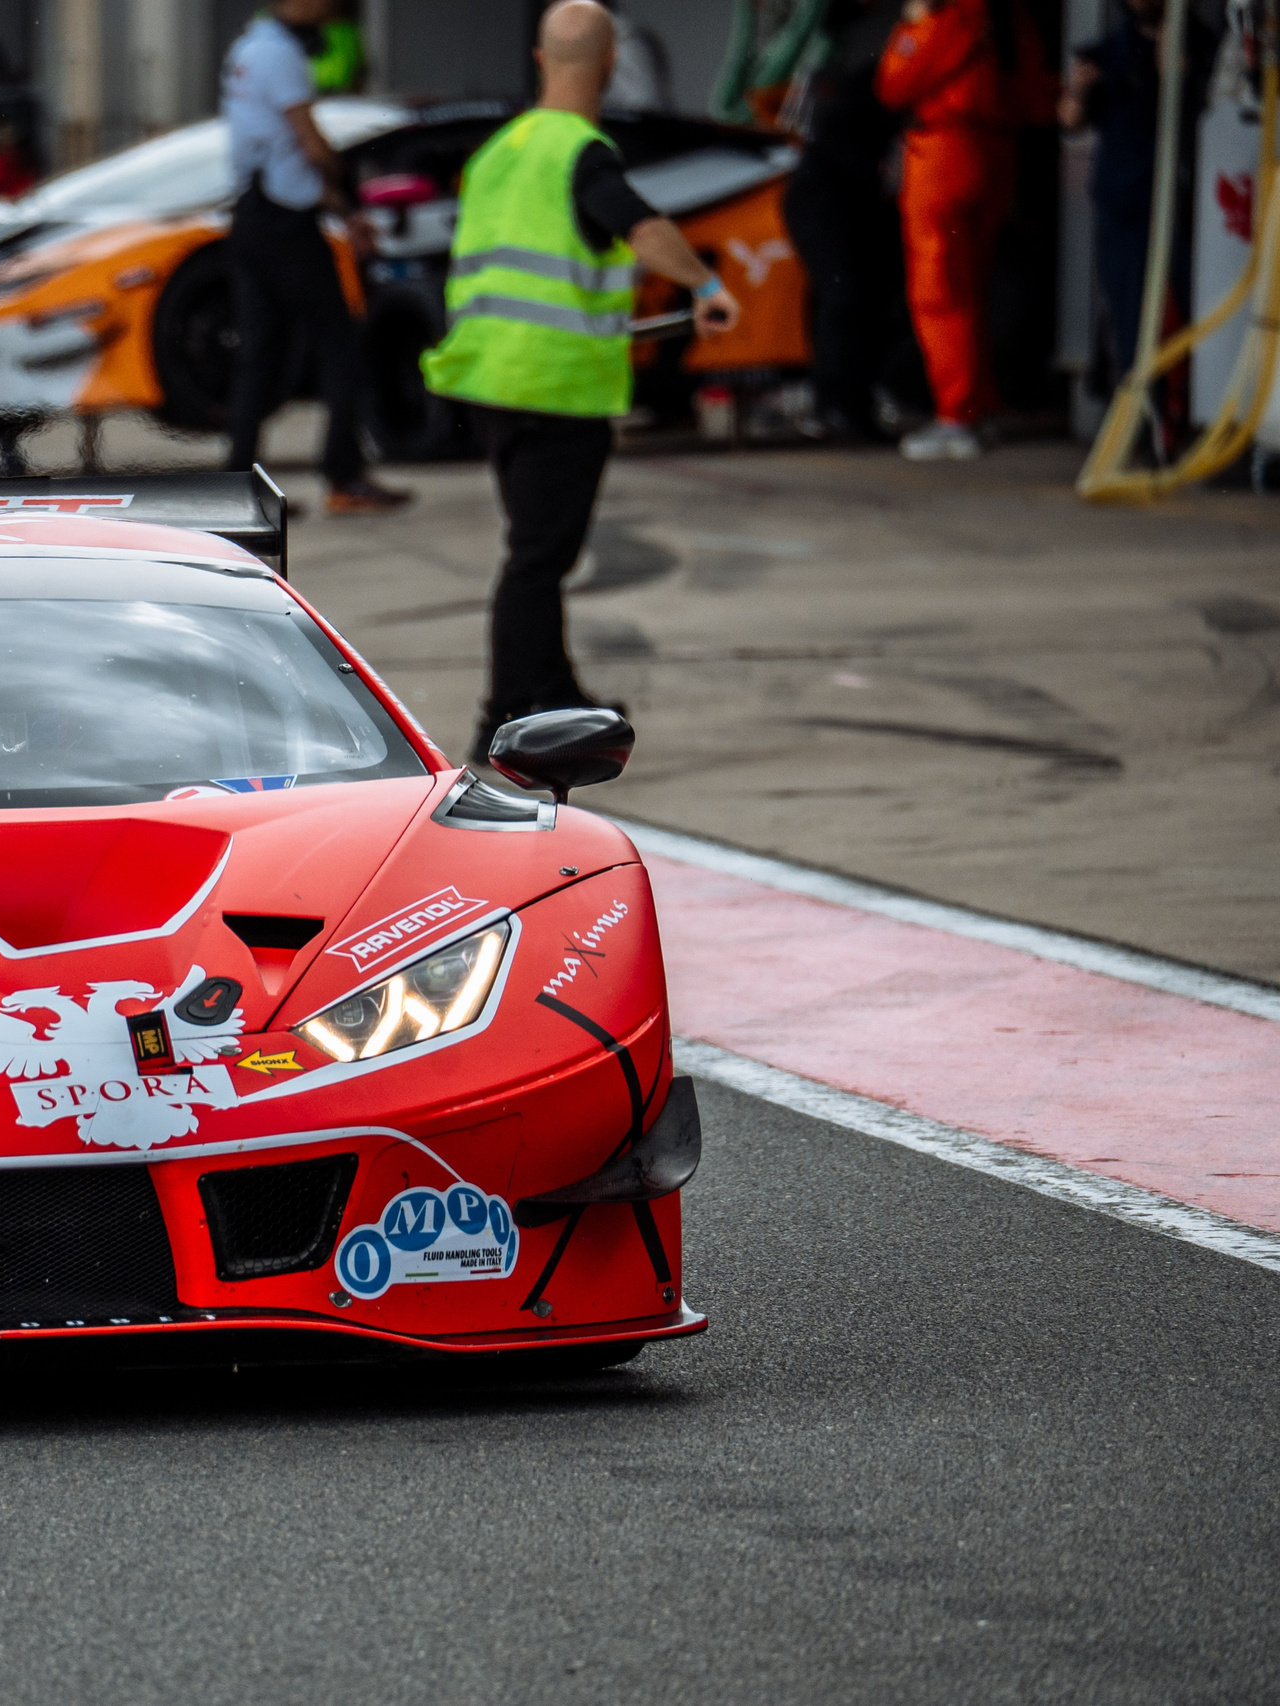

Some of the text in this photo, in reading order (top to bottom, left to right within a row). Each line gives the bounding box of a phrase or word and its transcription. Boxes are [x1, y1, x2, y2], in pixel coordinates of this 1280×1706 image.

[350, 898, 466, 959] RAVENOL
[423, 1250, 445, 1262] FLUID
[445, 1248, 481, 1260] HANDLING
[482, 1246, 502, 1258] TOOLS
[460, 1256, 502, 1268] MADE IN ITALY
